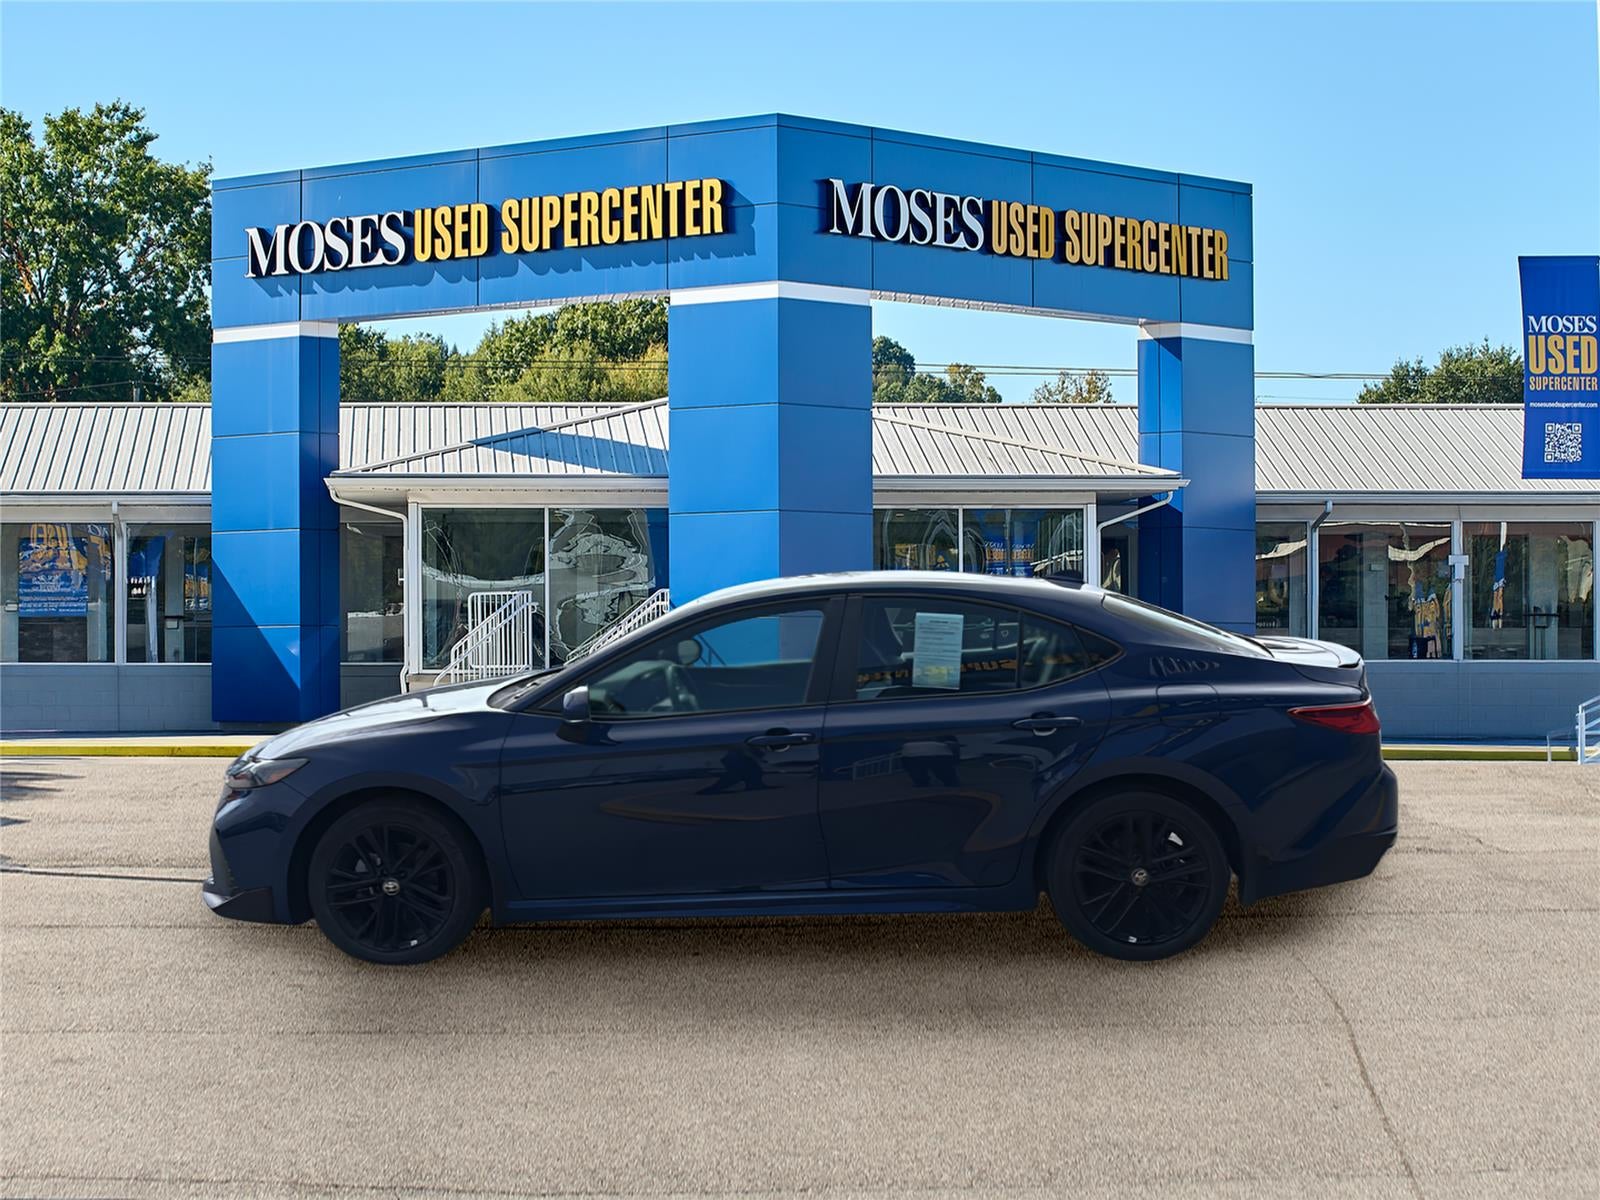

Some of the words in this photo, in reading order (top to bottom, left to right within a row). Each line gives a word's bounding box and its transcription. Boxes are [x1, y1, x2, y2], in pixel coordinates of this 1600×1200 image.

[244, 211, 410, 278] MOSES
[412, 203, 490, 263] USED
[500, 178, 724, 254] SUPERCENTER
[828, 178, 985, 251] MOSES
[990, 199, 1056, 260] USED
[1064, 209, 1230, 281] SUPERCENTER
[1527, 315, 1597, 334] MOSES
[1528, 335, 1598, 375] USED
[1529, 376, 1598, 391] SUPERCENTER
